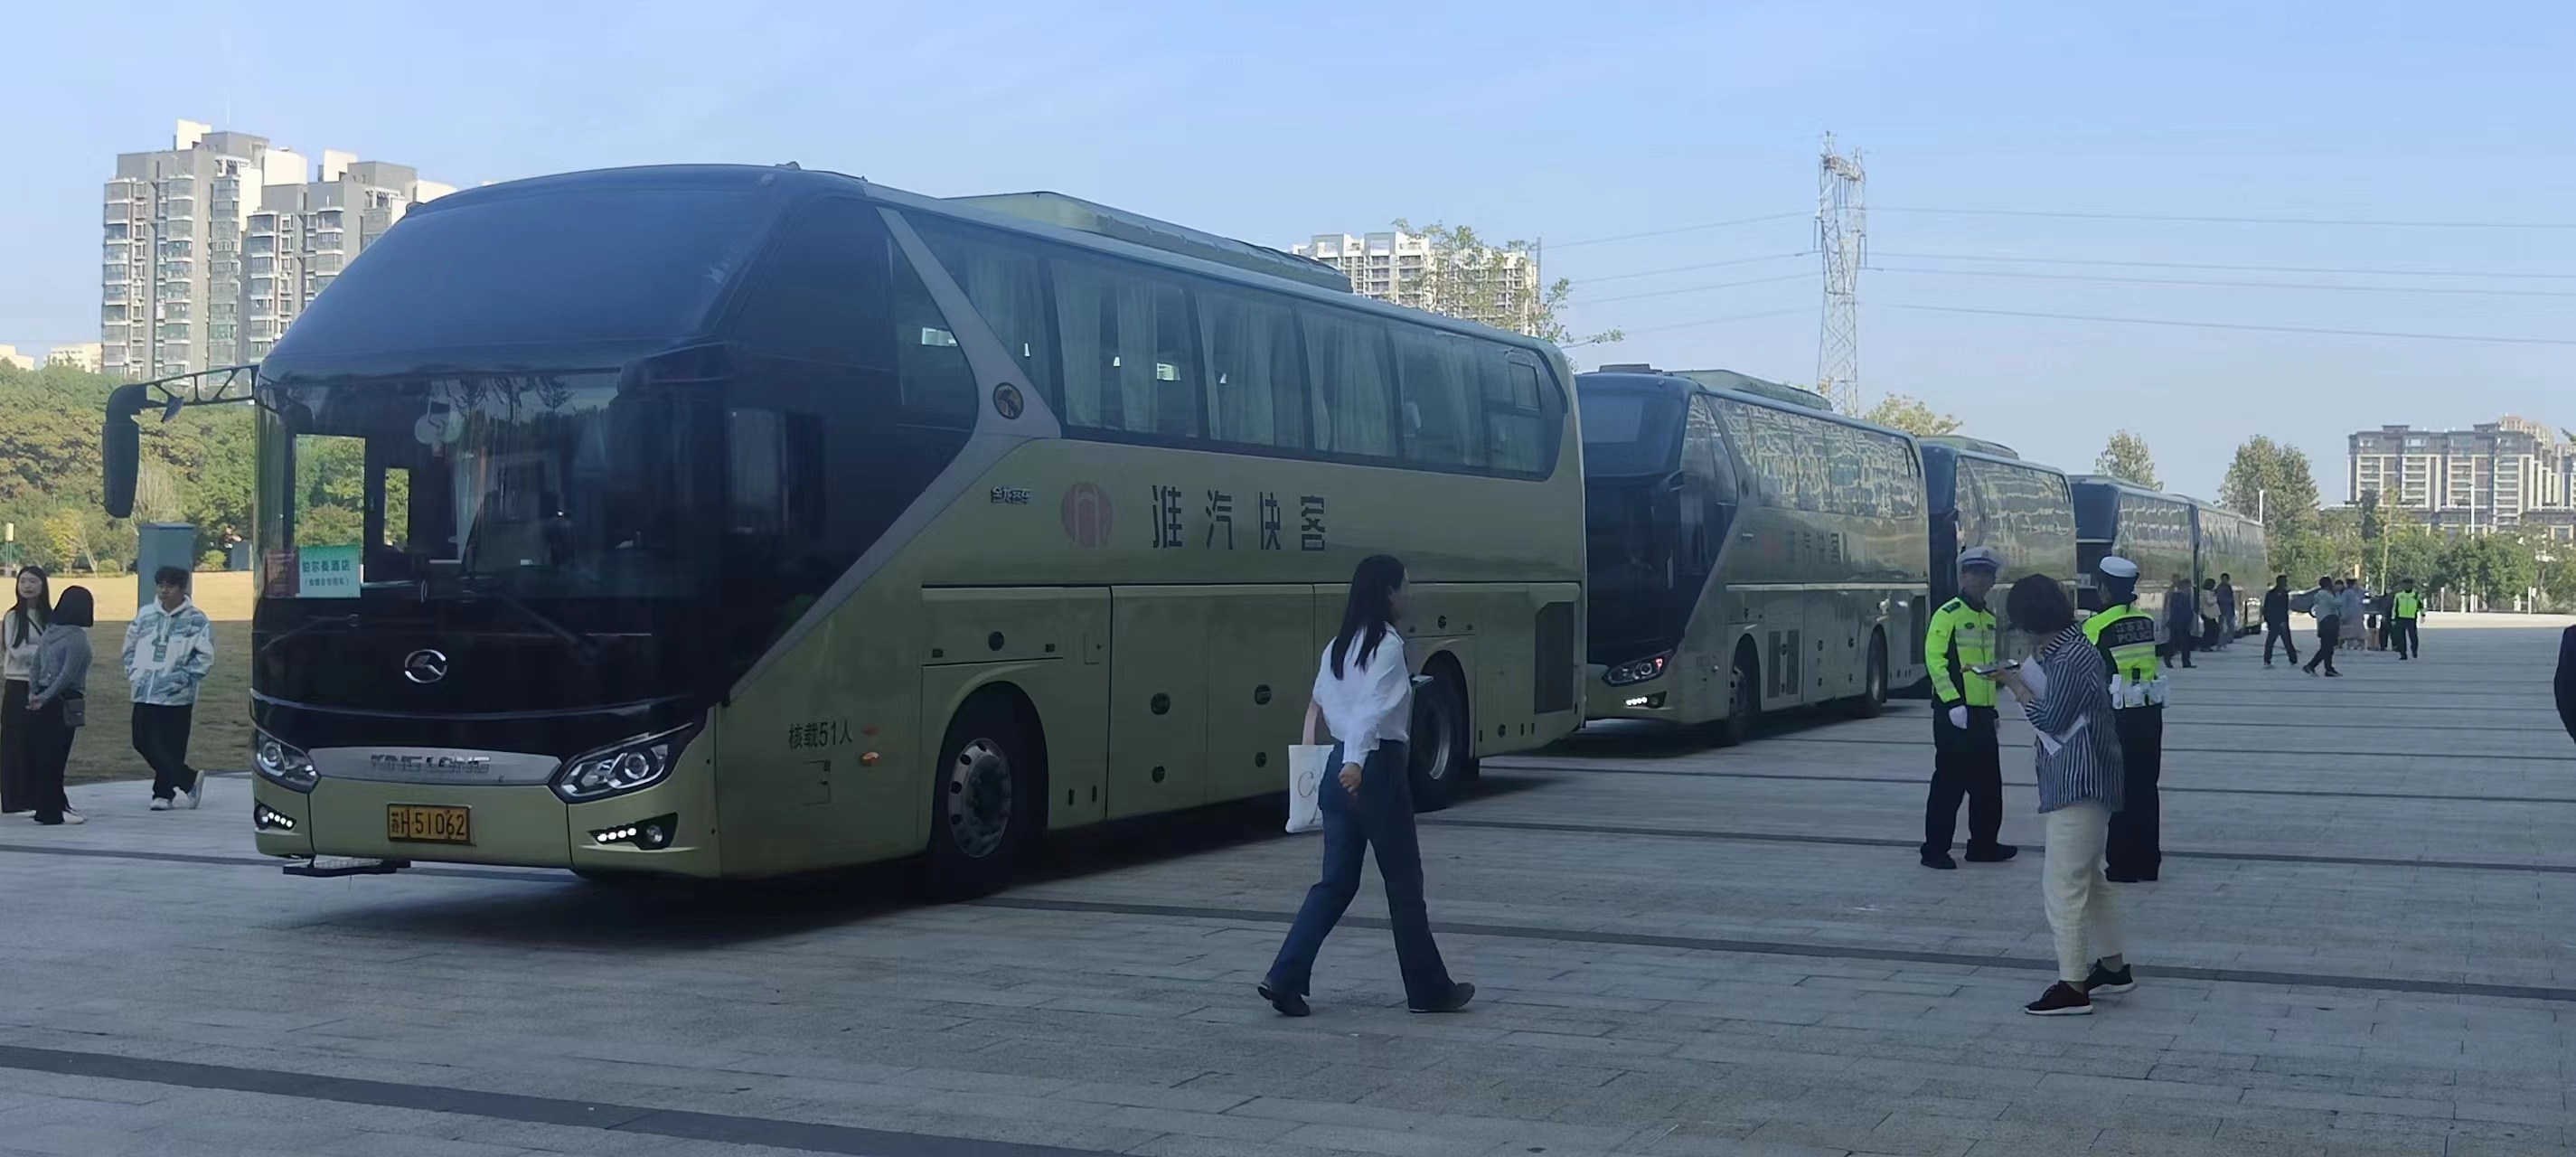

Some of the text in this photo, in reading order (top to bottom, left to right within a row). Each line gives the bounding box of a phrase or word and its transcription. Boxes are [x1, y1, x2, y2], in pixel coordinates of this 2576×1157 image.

[1152, 484, 1326, 551] 淮汽快客
[788, 718, 853, 750] 核载51人
[370, 754, 491, 774] KING LONG
